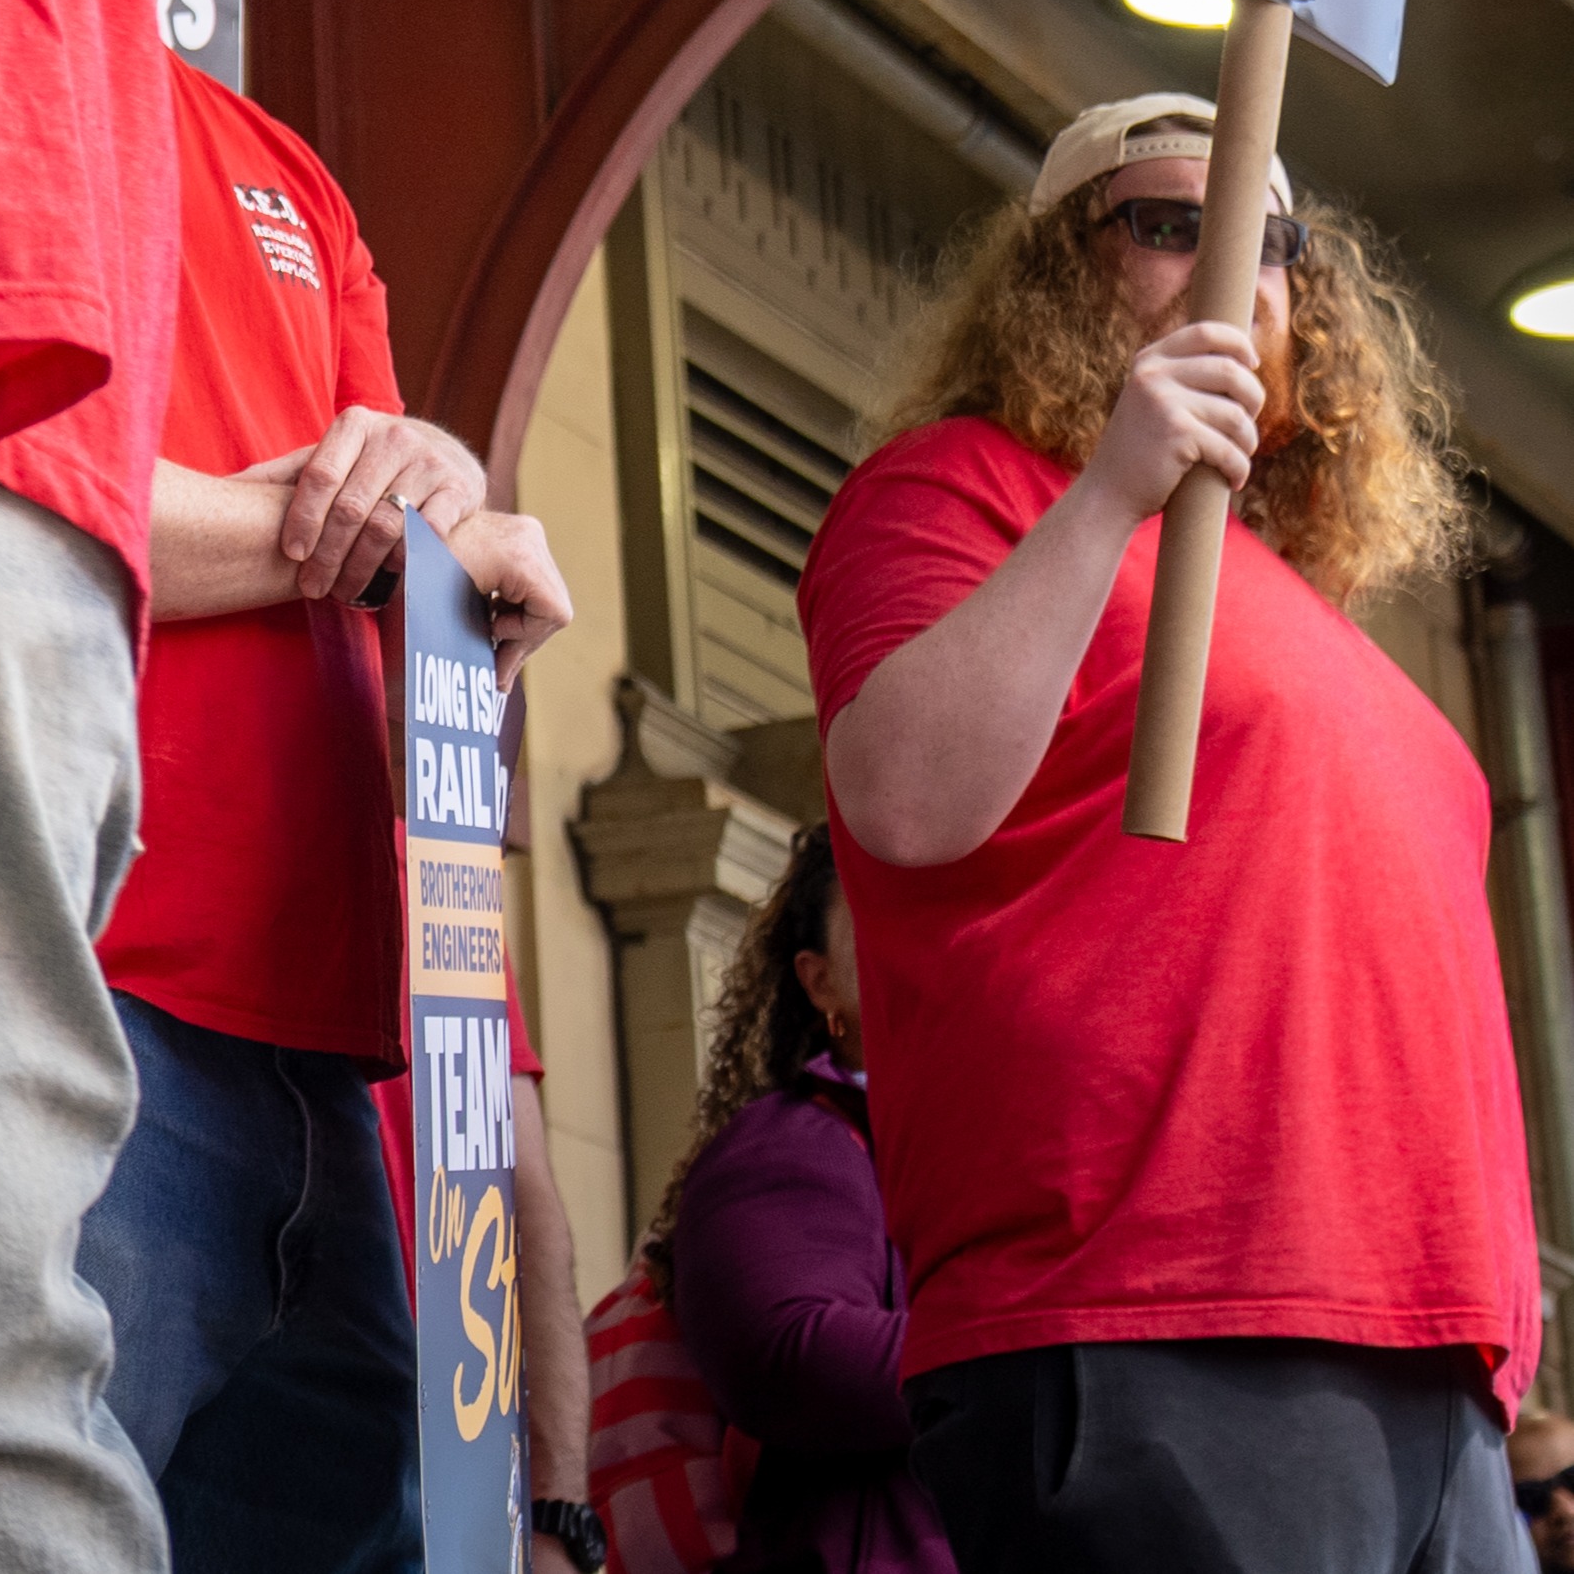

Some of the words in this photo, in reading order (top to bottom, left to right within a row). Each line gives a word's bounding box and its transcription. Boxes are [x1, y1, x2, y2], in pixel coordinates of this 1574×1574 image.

[415, 651, 466, 731] LONG
[415, 737, 491, 830] RAIL
[422, 922, 500, 975] ENGINEERS
[430, 1163, 465, 1264] On
